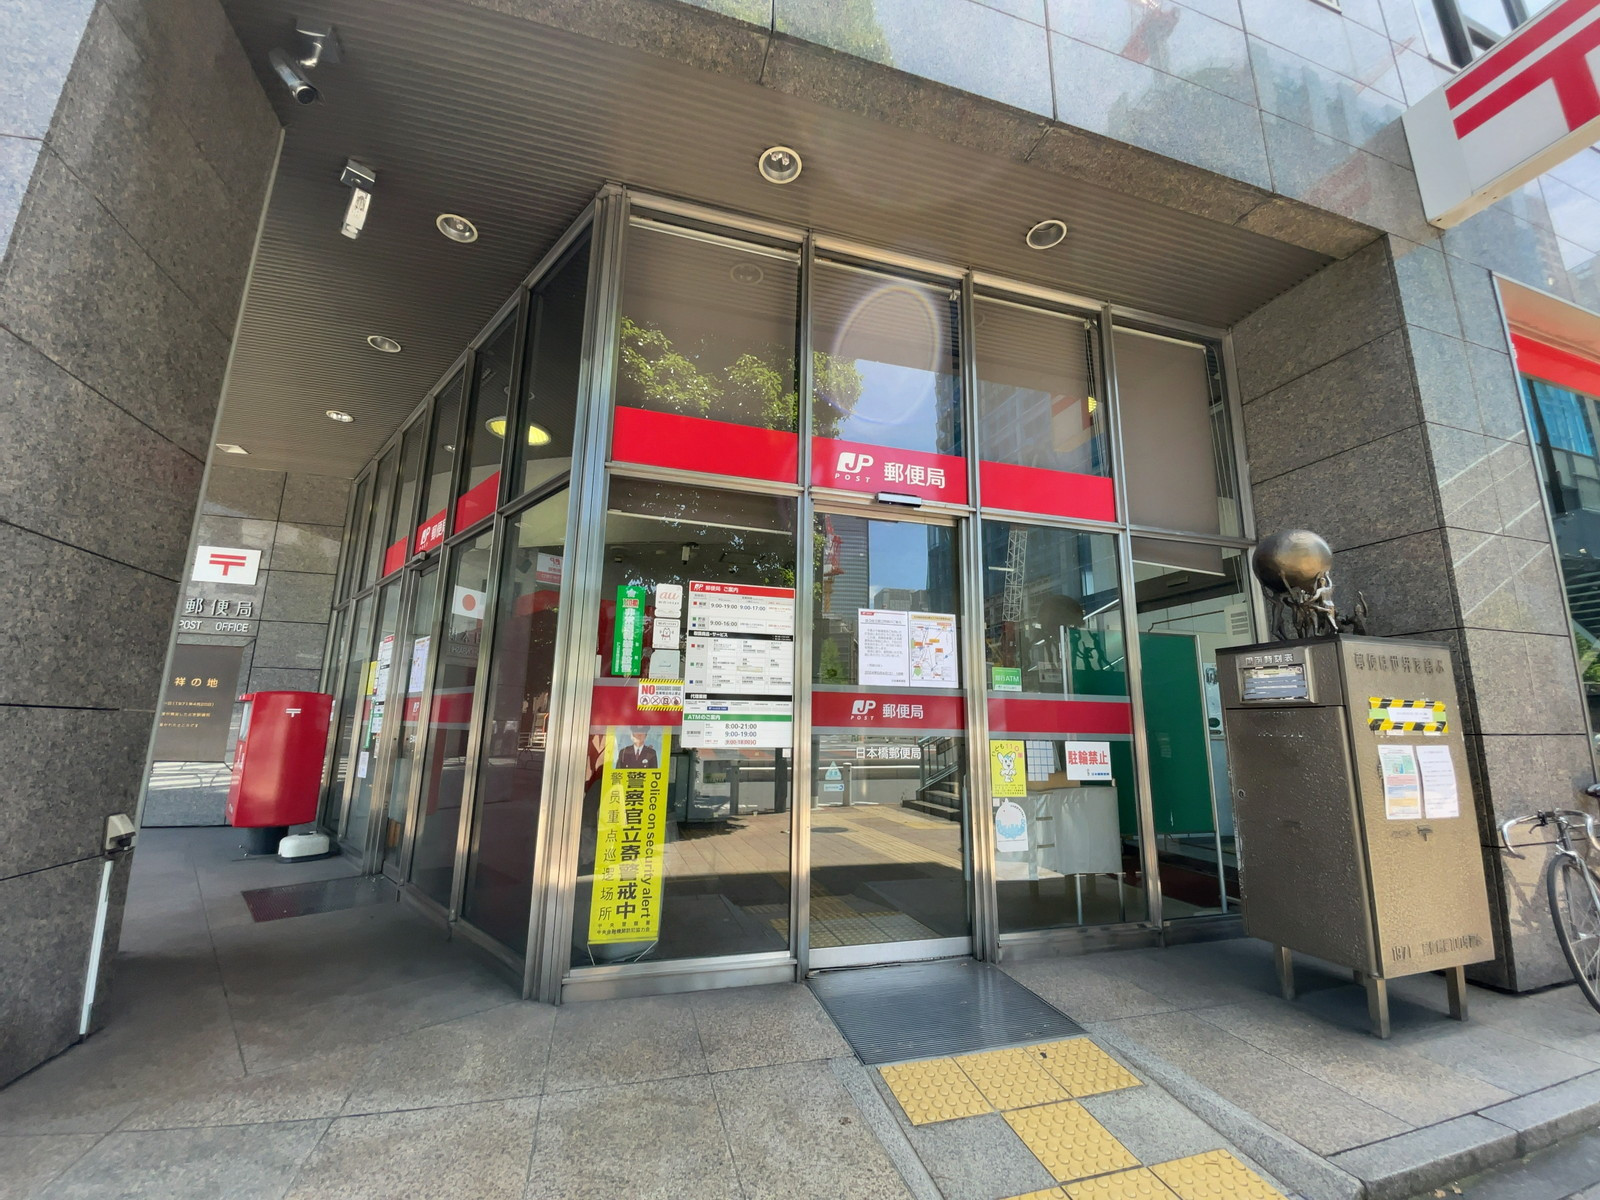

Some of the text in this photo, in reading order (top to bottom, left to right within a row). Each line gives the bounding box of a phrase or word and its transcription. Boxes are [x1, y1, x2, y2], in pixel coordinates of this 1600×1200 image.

[836, 452, 874, 473] JP
[835, 472, 870, 483] POST
[883, 462, 946, 489] 郵便局
[659, 591, 680, 600] au
[185, 598, 253, 617] 郵便局
[179, 620, 250, 633] POST OFFICE
[174, 677, 219, 688] 祥の地
[641, 684, 656, 695] NO
[851, 700, 876, 715] JP
[882, 703, 924, 720] 郵便局
[856, 747, 922, 760] 日本橋郵便局
[1067, 750, 1109, 765] 駐輪禁止
[598, 772, 623, 921] 警员重点巡逻场所
[615, 771, 646, 920] 警察官立寄警戒中
[640, 772, 662, 918] Police on security alert
